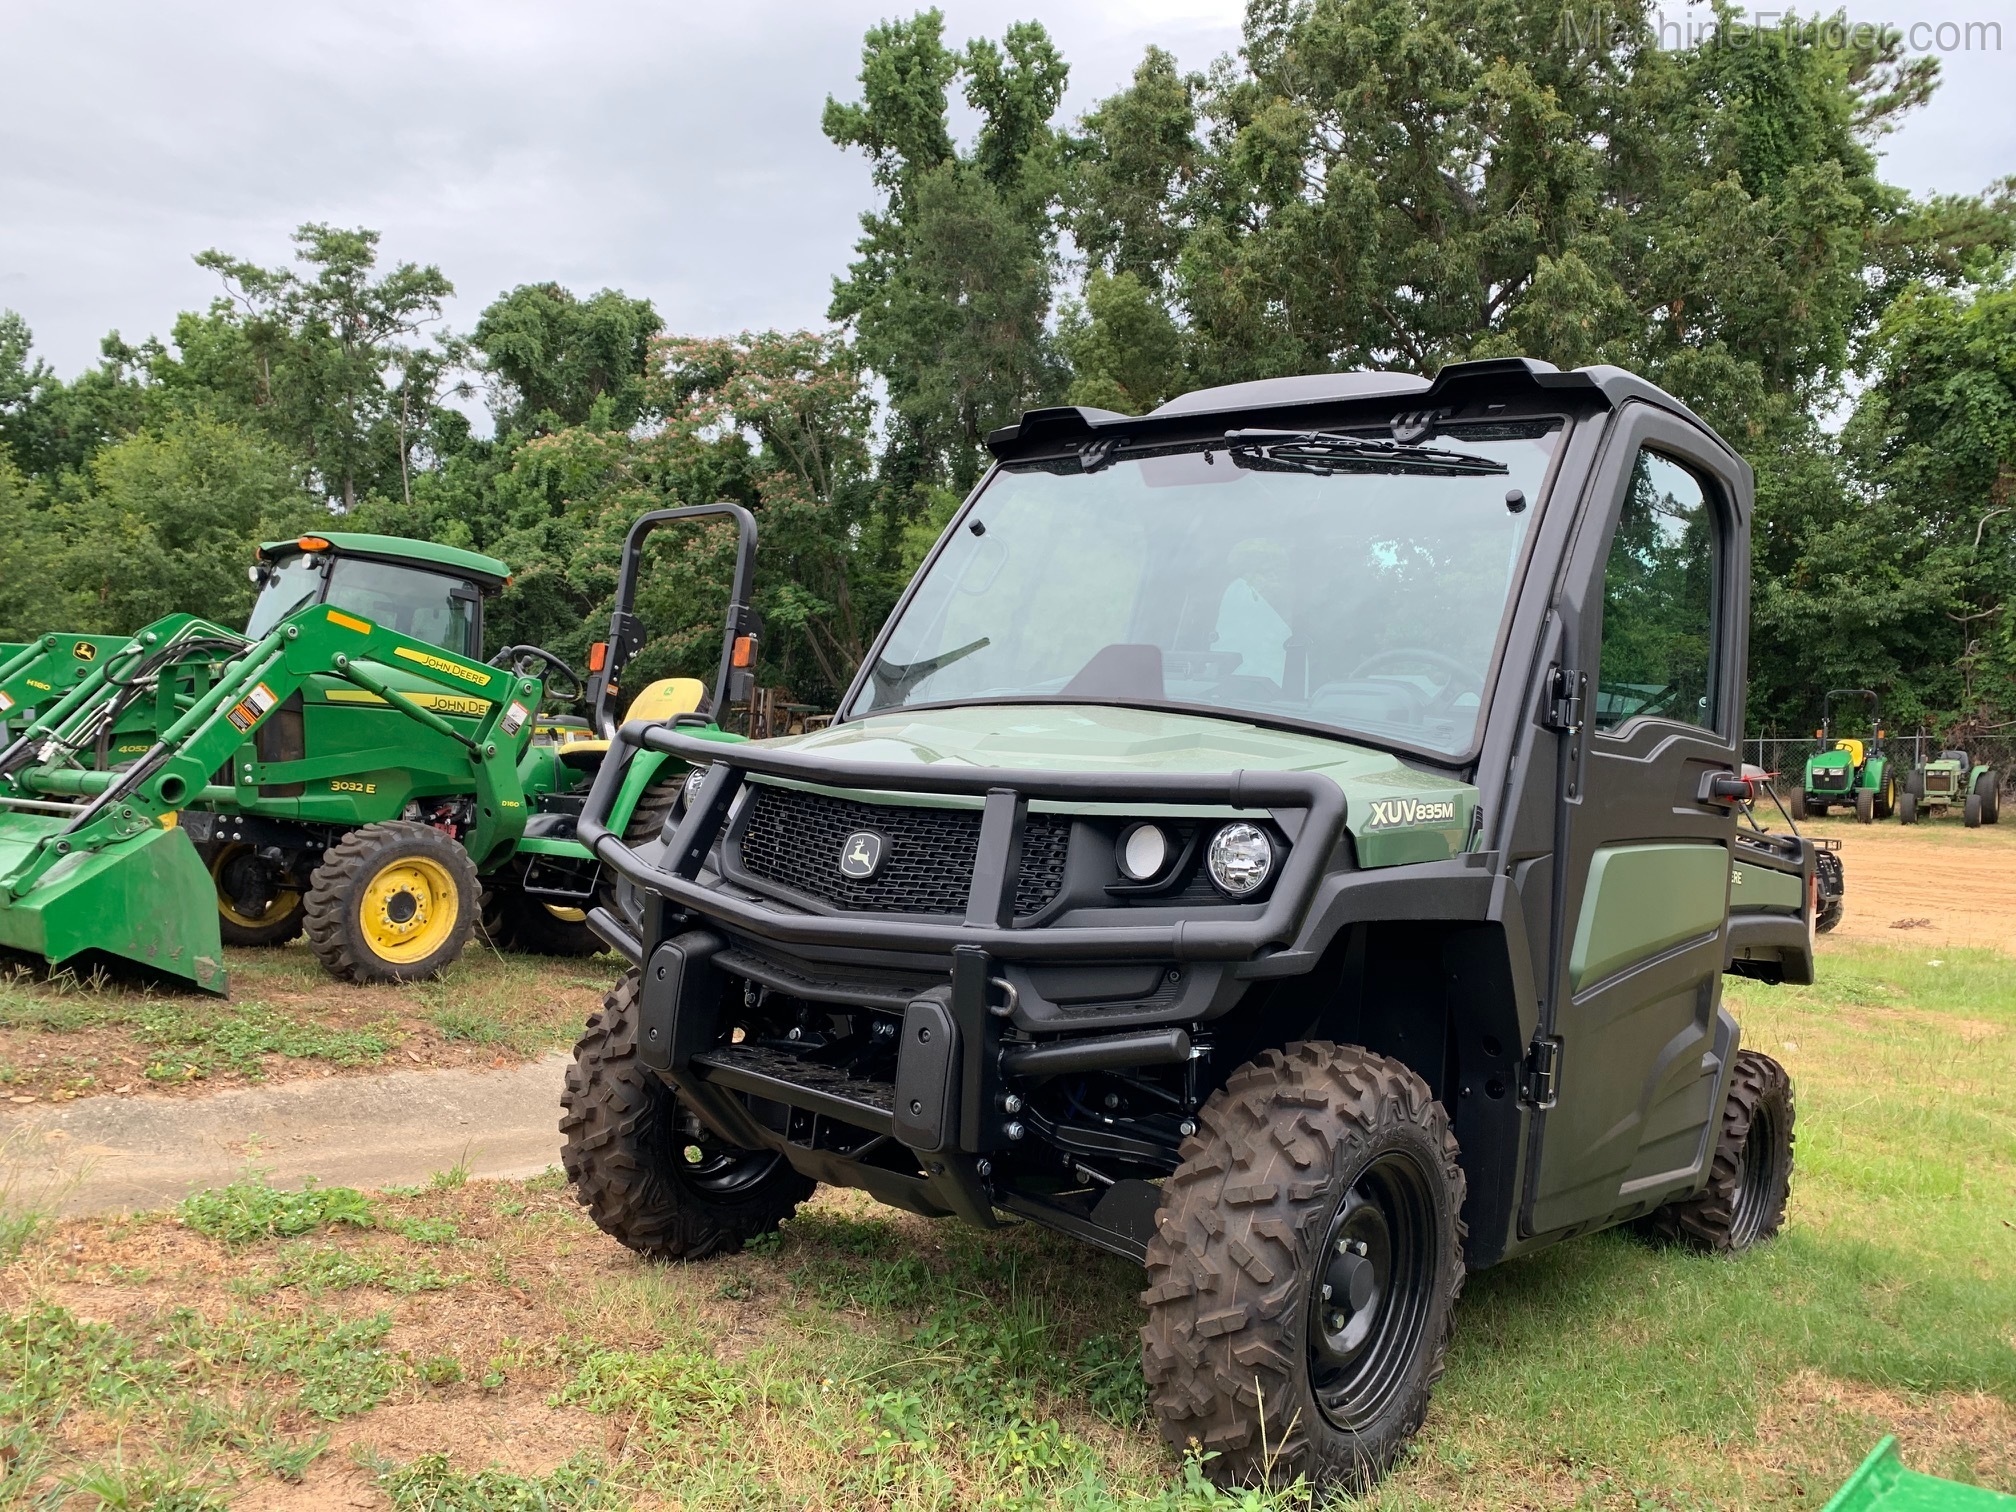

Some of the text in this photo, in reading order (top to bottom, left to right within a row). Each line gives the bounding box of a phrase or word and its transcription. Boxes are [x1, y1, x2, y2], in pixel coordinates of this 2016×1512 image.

[422, 656, 486, 685] JOHN DEERE
[429, 696, 466, 712] JOHN
[330, 780, 376, 794] 3032 E
[1370, 798, 1455, 827] XUV835M
